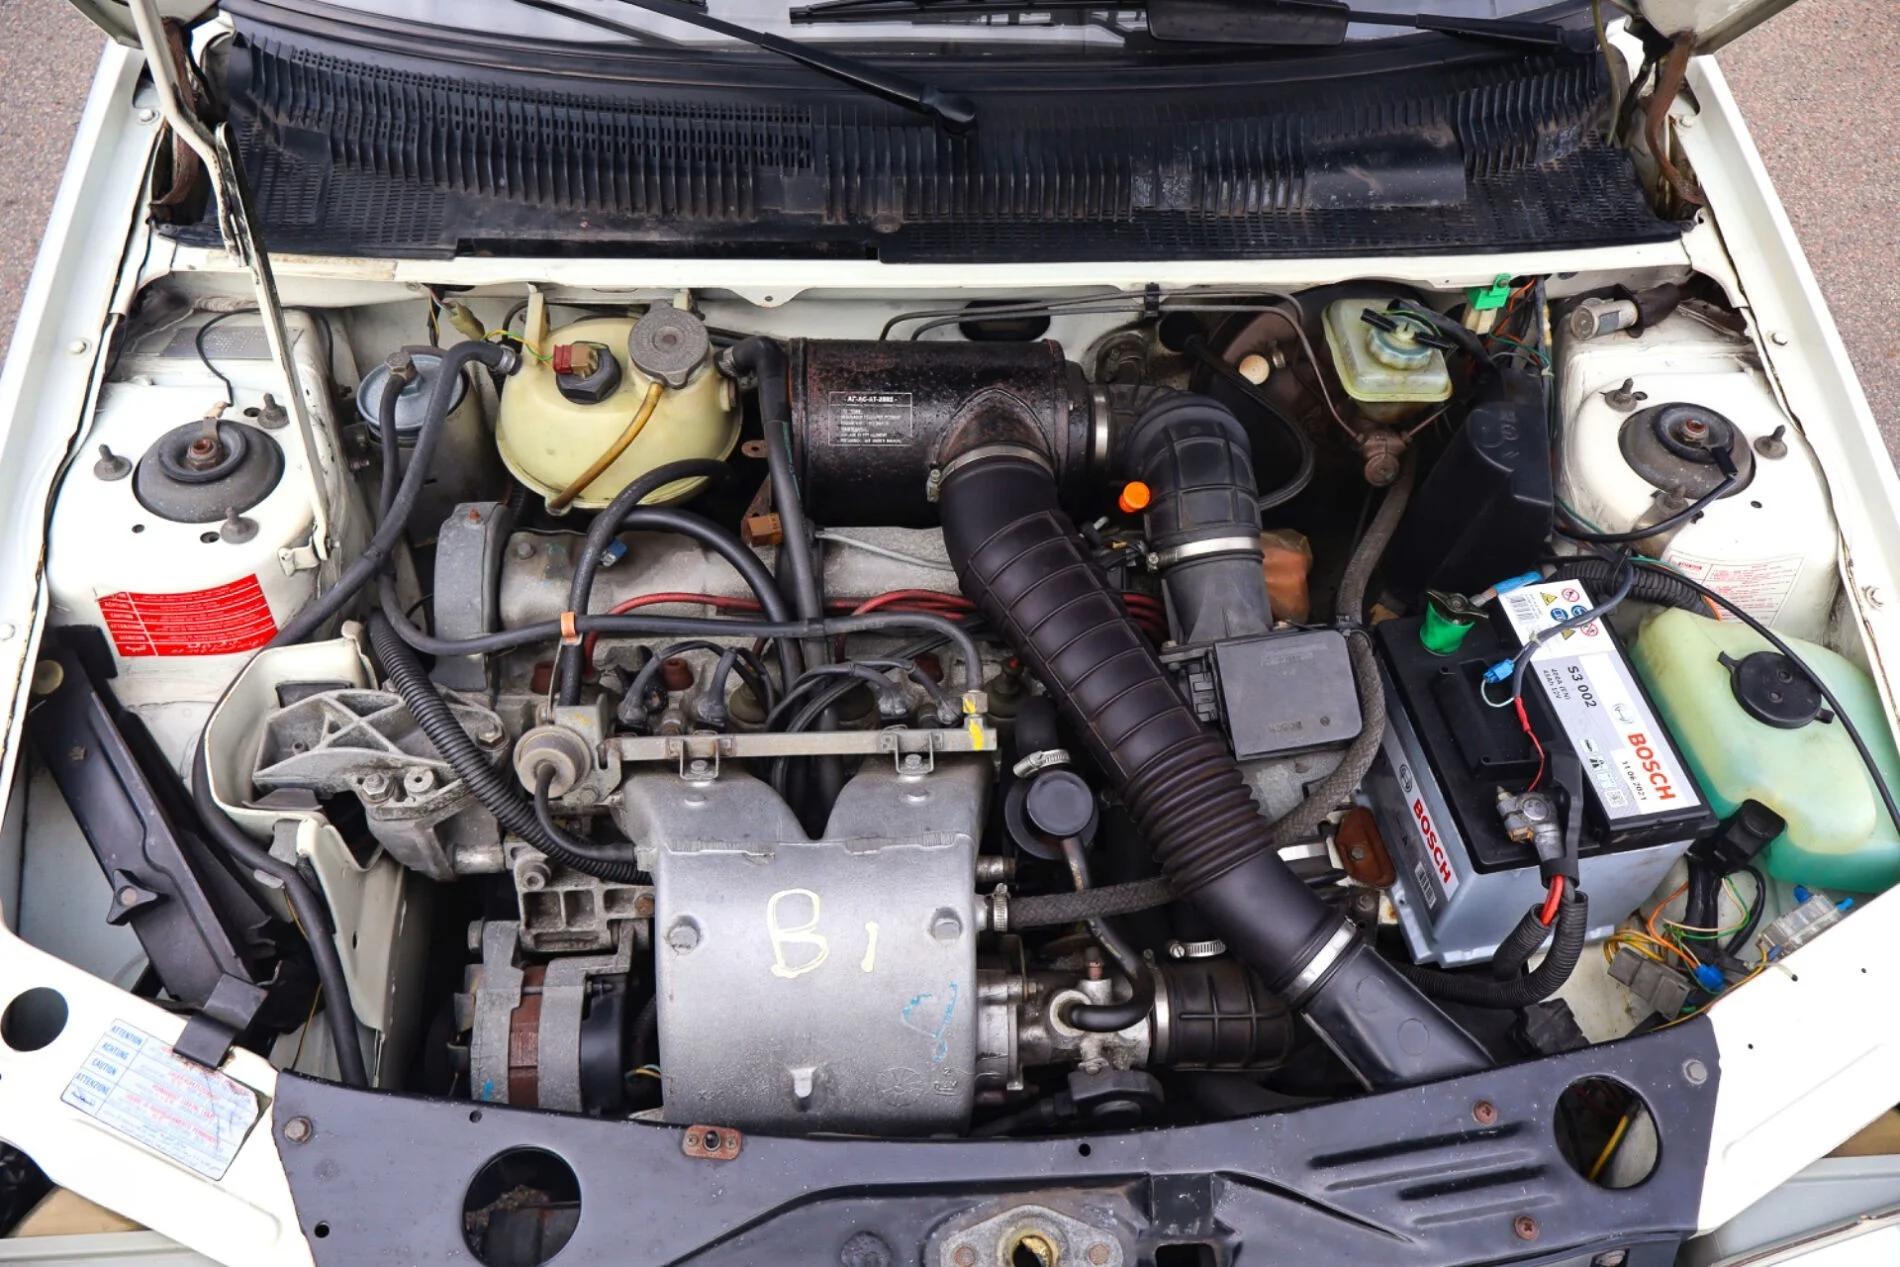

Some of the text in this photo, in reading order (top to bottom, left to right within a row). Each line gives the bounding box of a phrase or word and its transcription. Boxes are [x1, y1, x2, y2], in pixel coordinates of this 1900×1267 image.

[1567, 665, 1597, 708] S3 002
[1628, 731, 1677, 800] BOSCH
[1413, 798, 1452, 884] BOSCH
[111, 1025, 143, 1046] ATTENTION
[91, 1058, 118, 1076] CAUTION
